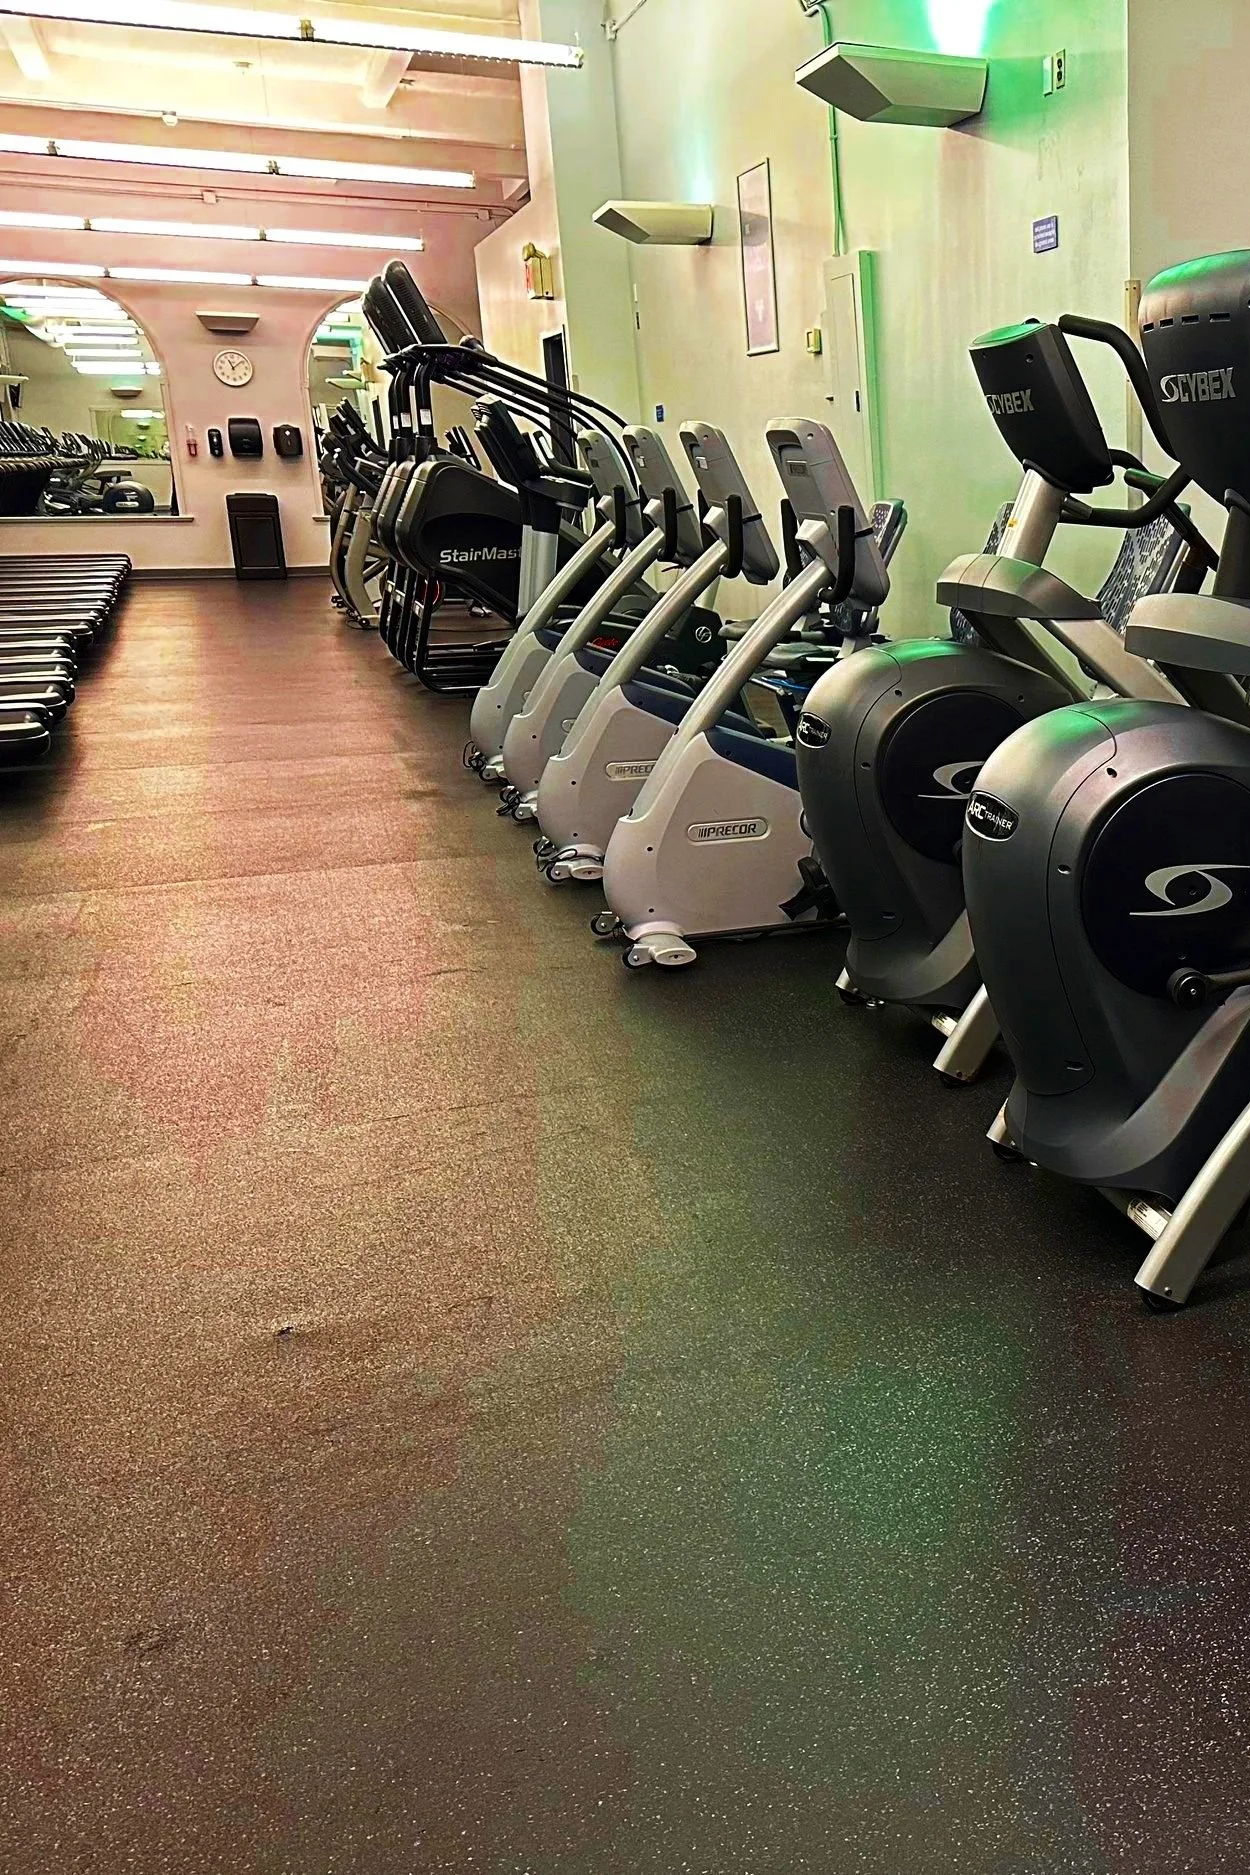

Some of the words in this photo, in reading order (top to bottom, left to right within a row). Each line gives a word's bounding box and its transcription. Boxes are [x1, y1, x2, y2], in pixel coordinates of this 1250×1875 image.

[1176, 366, 1237, 403] CYBEX
[991, 388, 1035, 415] CYBEX
[967, 799, 987, 820] ARC
[705, 823, 757, 838] PRECOR
